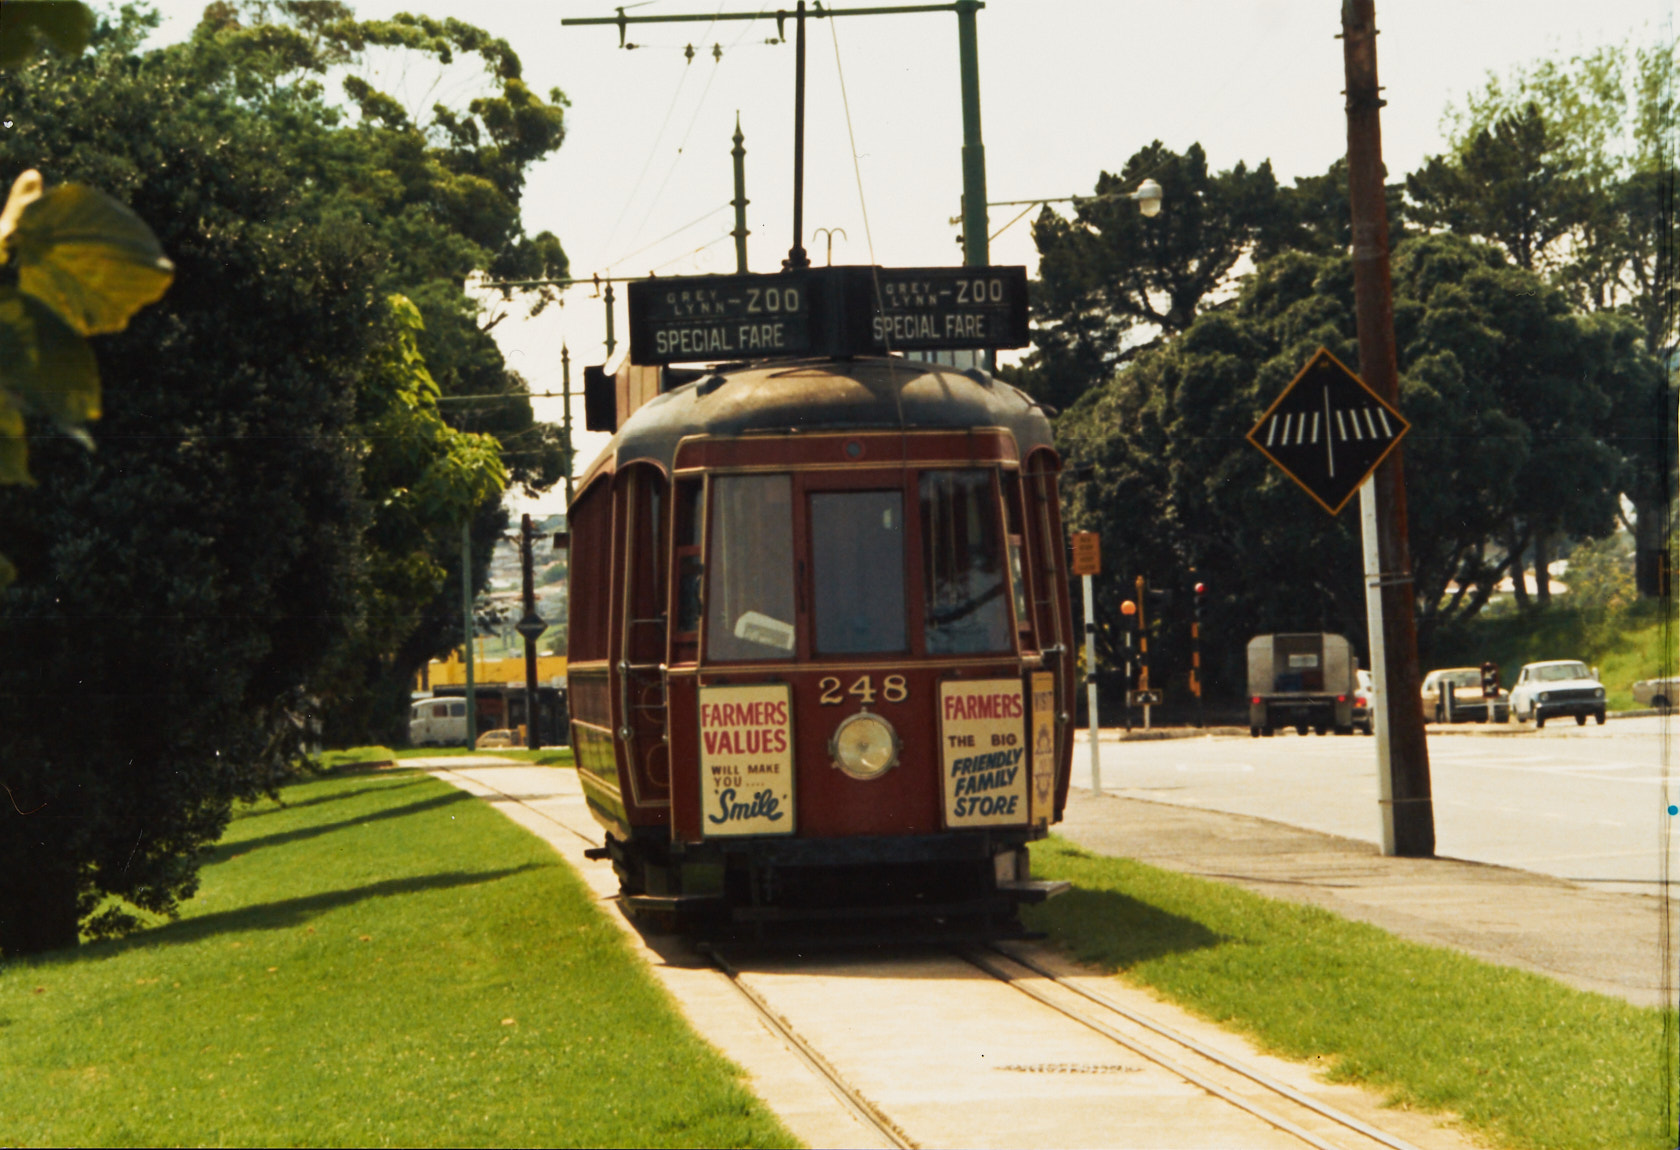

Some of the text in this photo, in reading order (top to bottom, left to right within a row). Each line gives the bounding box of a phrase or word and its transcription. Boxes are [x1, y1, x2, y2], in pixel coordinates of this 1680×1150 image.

[667, 290, 717, 304] GREY
[886, 282, 930, 294] GREY
[893, 295, 937, 306] LYNN
[674, 302, 725, 315] LYNN
[656, 323, 784, 353] SPECIAL FARE
[873, 314, 985, 340] SPECIAL FARE
[818, 674, 908, 704] 248
[701, 701, 787, 727] FARMERS
[944, 693, 1023, 720] FARMERS
[704, 729, 787, 755] VALUES
[948, 733, 1017, 747] THE BIG
[711, 763, 780, 775] WILL MAKE
[952, 747, 1023, 777] FRIENDLY
[954, 766, 1019, 797] FAMILY
[954, 795, 1019, 817] STORE
